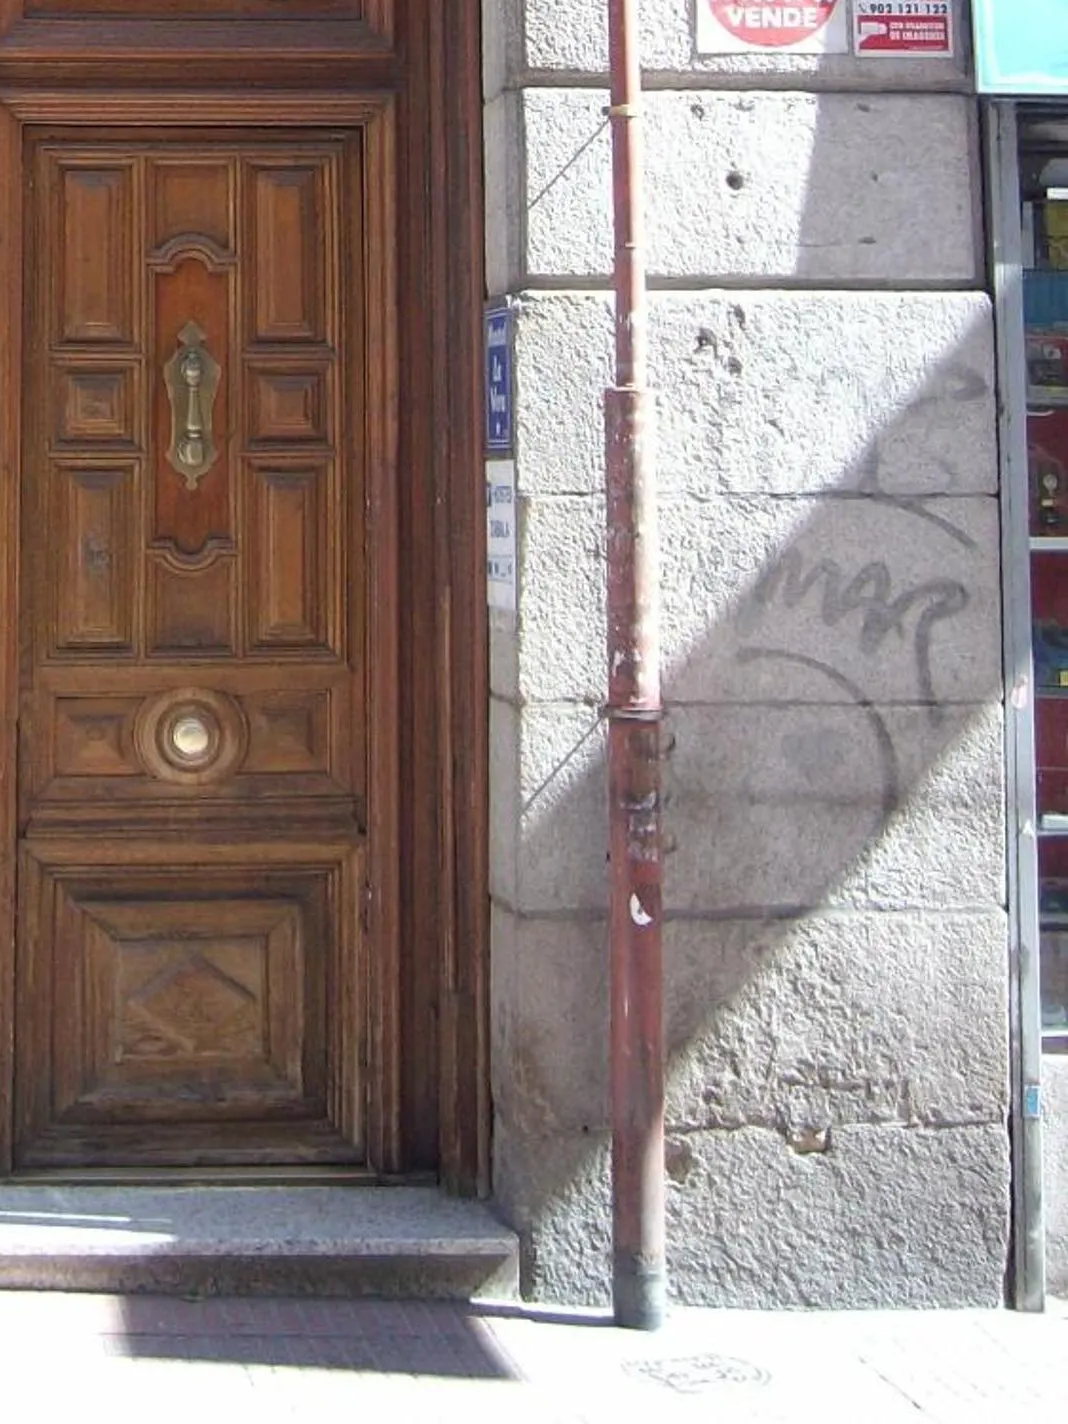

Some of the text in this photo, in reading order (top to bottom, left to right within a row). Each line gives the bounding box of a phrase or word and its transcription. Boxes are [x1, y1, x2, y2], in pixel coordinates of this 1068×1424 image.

[870, 4, 948, 14] 902 121 122
[724, 6, 818, 29] VENDE
